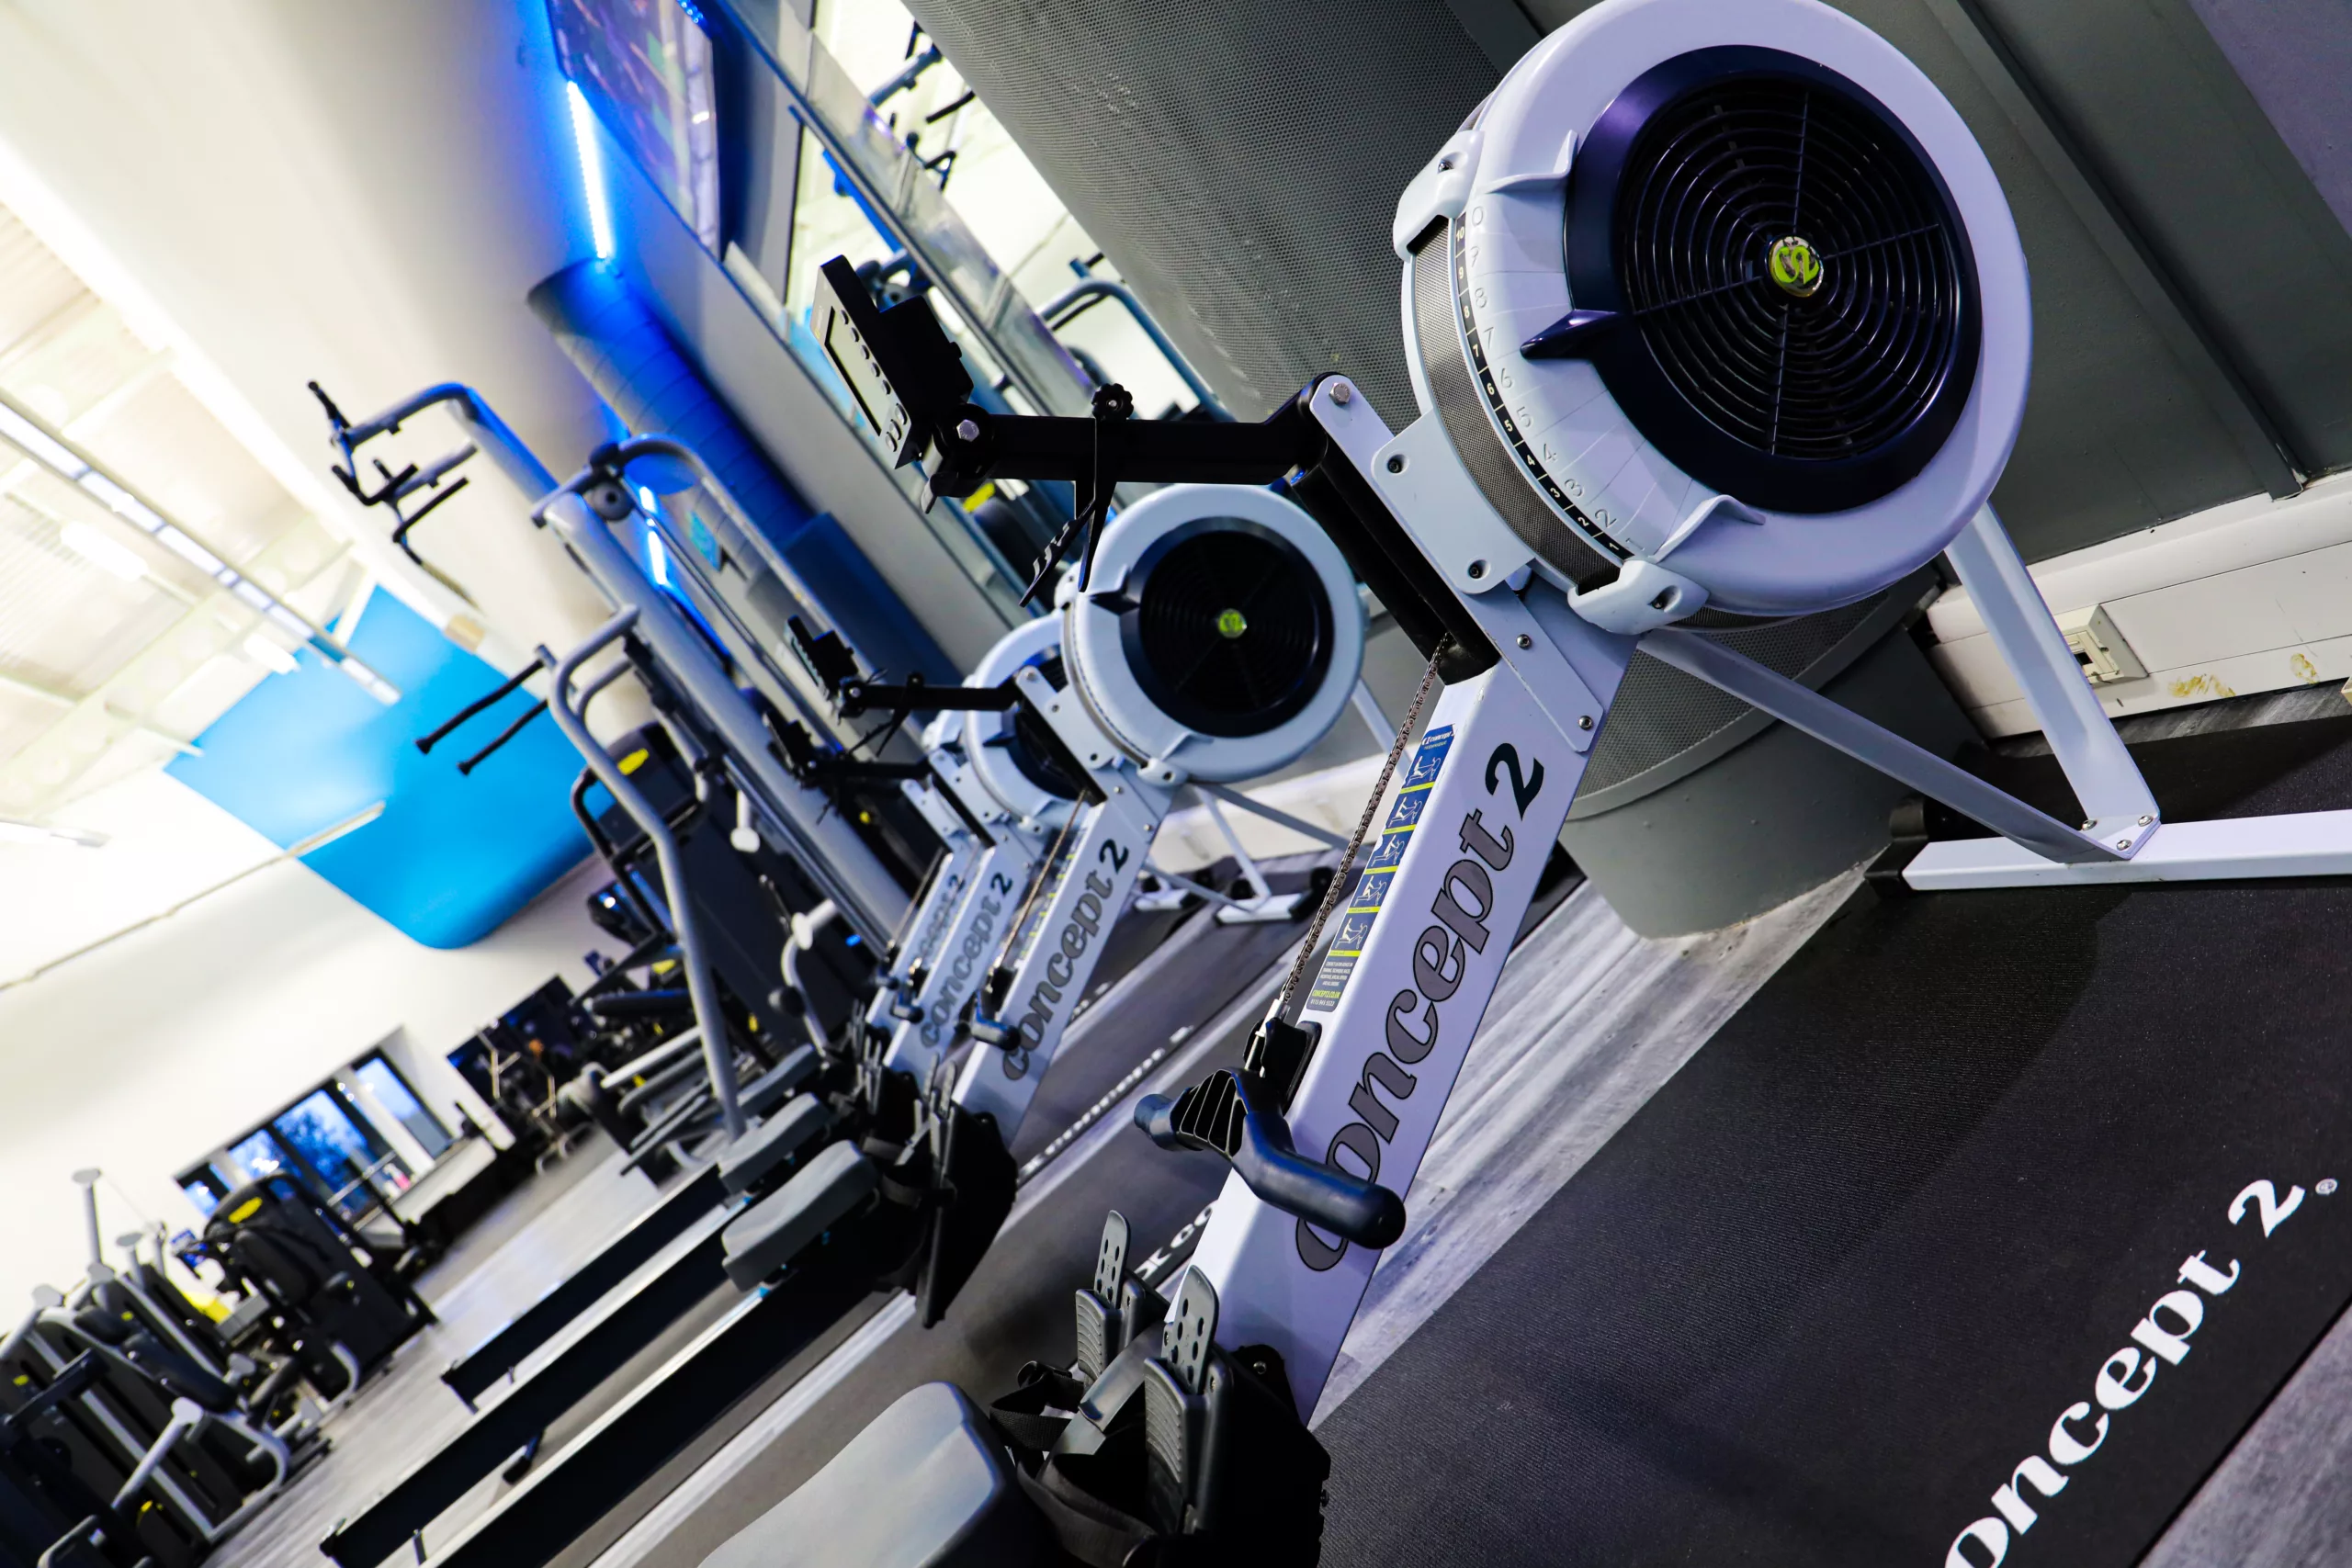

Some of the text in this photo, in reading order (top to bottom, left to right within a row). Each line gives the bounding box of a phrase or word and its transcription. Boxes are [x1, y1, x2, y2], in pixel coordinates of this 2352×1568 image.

[1456, 226, 1464, 242] 10
[1469, 245, 1480, 267] 9
[1458, 267, 1464, 278] 9
[1475, 287, 1488, 309] 8
[1464, 306, 1470, 319] 8
[1483, 326, 1495, 350] 7
[1473, 344, 1480, 357] 7
[1500, 367, 1513, 389] 6
[1487, 382, 1496, 395] 6
[1504, 419, 1513, 432] 5
[1517, 406, 1533, 428] 5
[1526, 455, 1535, 466] 4
[1543, 443, 1557, 464] 4
[1550, 487, 1561, 498] 3
[1564, 478, 1584, 498] 3
[1577, 517, 1589, 526] 2
[1594, 508, 1618, 529] 2
[1609, 542, 1620, 551] 1
[1624, 537, 1645, 552] 1
[1485, 742, 1544, 820] 2
[921, 872, 1013, 1048] concept 2
[1002, 869, 1114, 1081] concept
[1099, 838, 1129, 874] 2
[2228, 1179, 2306, 1238] 2
